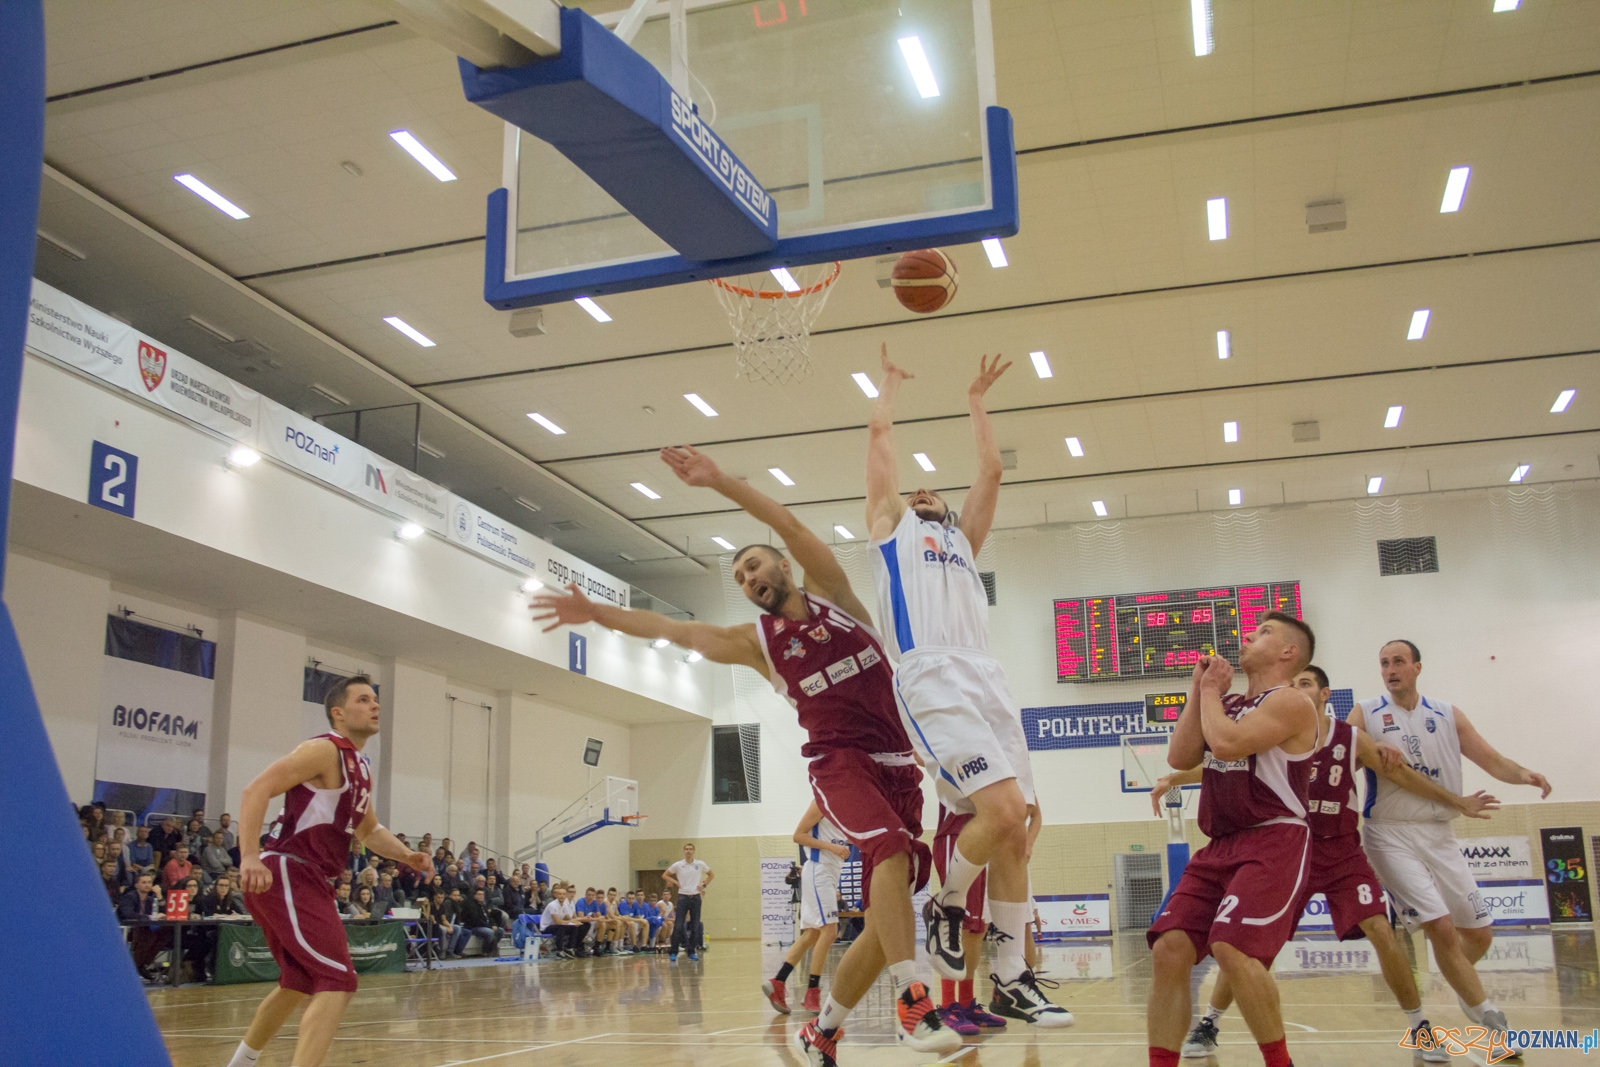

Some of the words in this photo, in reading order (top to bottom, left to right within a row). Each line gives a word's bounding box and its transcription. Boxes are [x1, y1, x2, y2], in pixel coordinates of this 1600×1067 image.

[30, 313, 82, 345] Szkolnictwa
[83, 338, 123, 365] Wyższego
[84, 324, 109, 343] Nauki
[101, 453, 127, 508] 2
[477, 516, 500, 537] Centrum
[1146, 612, 1167, 627] 58
[1191, 608, 1212, 624] 65
[1133, 635, 1140, 643] 2
[575, 638, 583, 670] 1
[830, 664, 855, 680] MPGK
[803, 679, 823, 694] PEC
[1154, 695, 1185, 705] 2.59.4
[1163, 707, 1178, 720] 16
[112, 704, 198, 740] BIOFARM
[962, 756, 989, 779] PBG
[1328, 764, 1344, 787] 8
[1499, 859, 1529, 868] hitem
[1356, 883, 1374, 905] 8
[1502, 907, 1525, 915] clinic
[1060, 917, 1100, 925] CYMES
